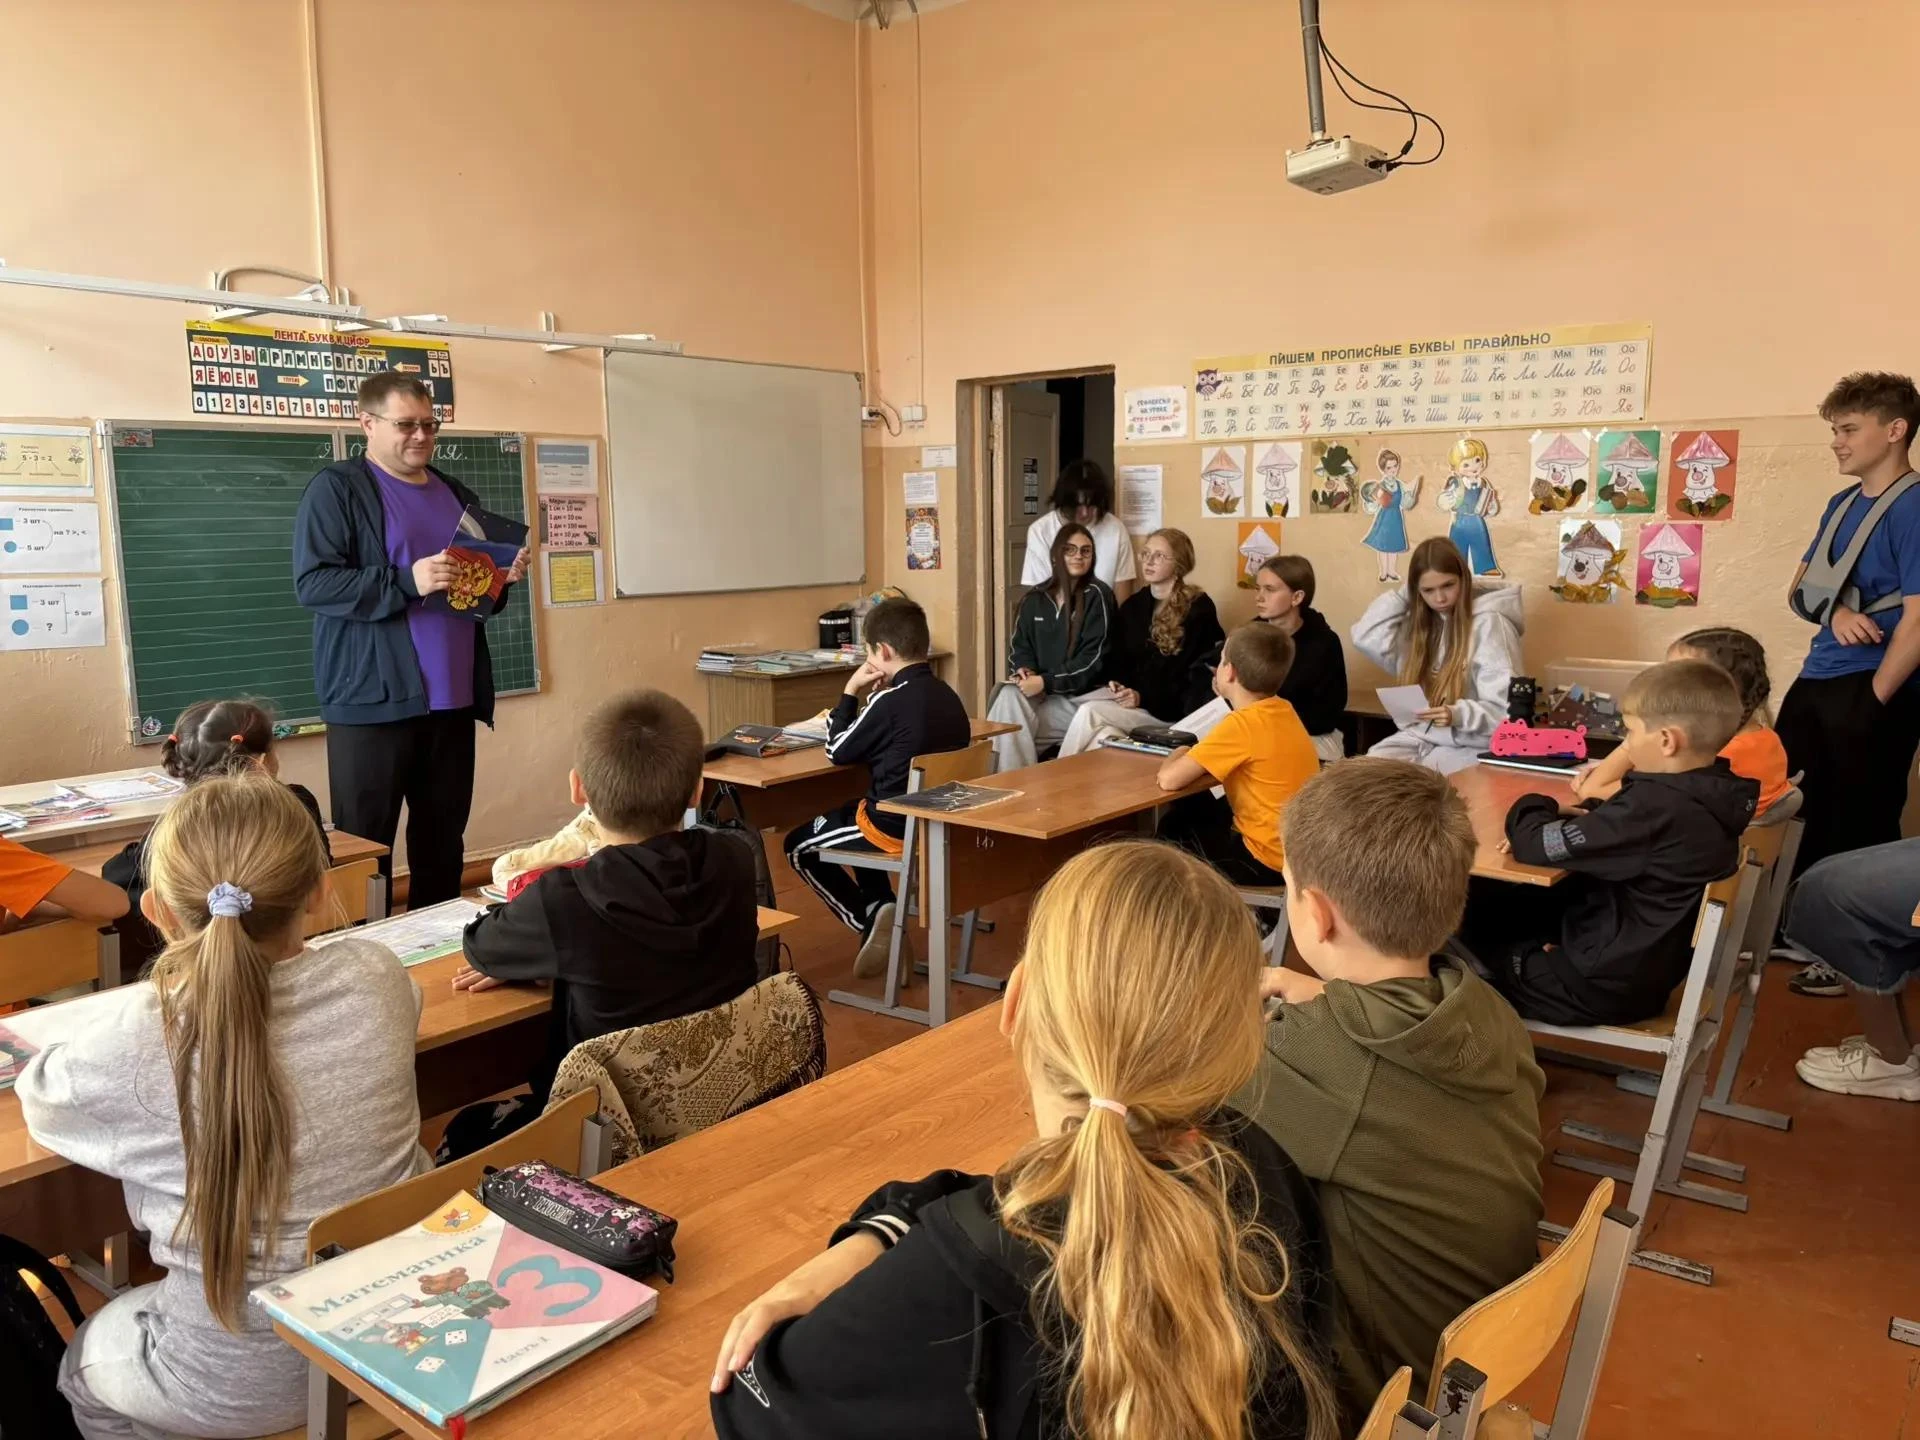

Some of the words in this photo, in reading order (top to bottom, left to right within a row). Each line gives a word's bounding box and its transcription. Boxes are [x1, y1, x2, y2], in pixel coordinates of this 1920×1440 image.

[274, 329, 305, 341] ЛЕНТА
[308, 332, 335, 343] БУКВ
[337, 335, 342, 345] И
[344, 335, 370, 347] ЦИФР
[1269, 352, 1315, 365] ПИШЕМ
[1321, 345, 1402, 360] ПРОПИСНЫЕ
[1409, 341, 1455, 353] БУКВЫ
[1464, 333, 1551, 349] ПРАВИЛЬНО
[193, 345, 201, 358] А
[206, 346, 214, 358] О
[221, 347, 228, 359] У
[245, 349, 255, 362] Ы
[272, 351, 280, 364] Р
[296, 353, 306, 366] М
[310, 354, 319, 366] Н
[324, 355, 332, 368] Б
[335, 355, 343, 368] В
[195, 369, 203, 382] Я
[208, 367, 215, 382] Ё
[220, 371, 231, 383] Ю
[236, 372, 243, 384] Е
[248, 373, 256, 385] И
[224, 398, 231, 408] 2
[252, 400, 258, 410] 4
[330, 404, 340, 414] 10
[343, 405, 352, 414] 11
[433, 406, 441, 417] 19
[443, 407, 452, 417] 20
[1562, 824, 1586, 845] AIR
[309, 1236, 487, 1317] Математика
[496, 1254, 604, 1318] 3
